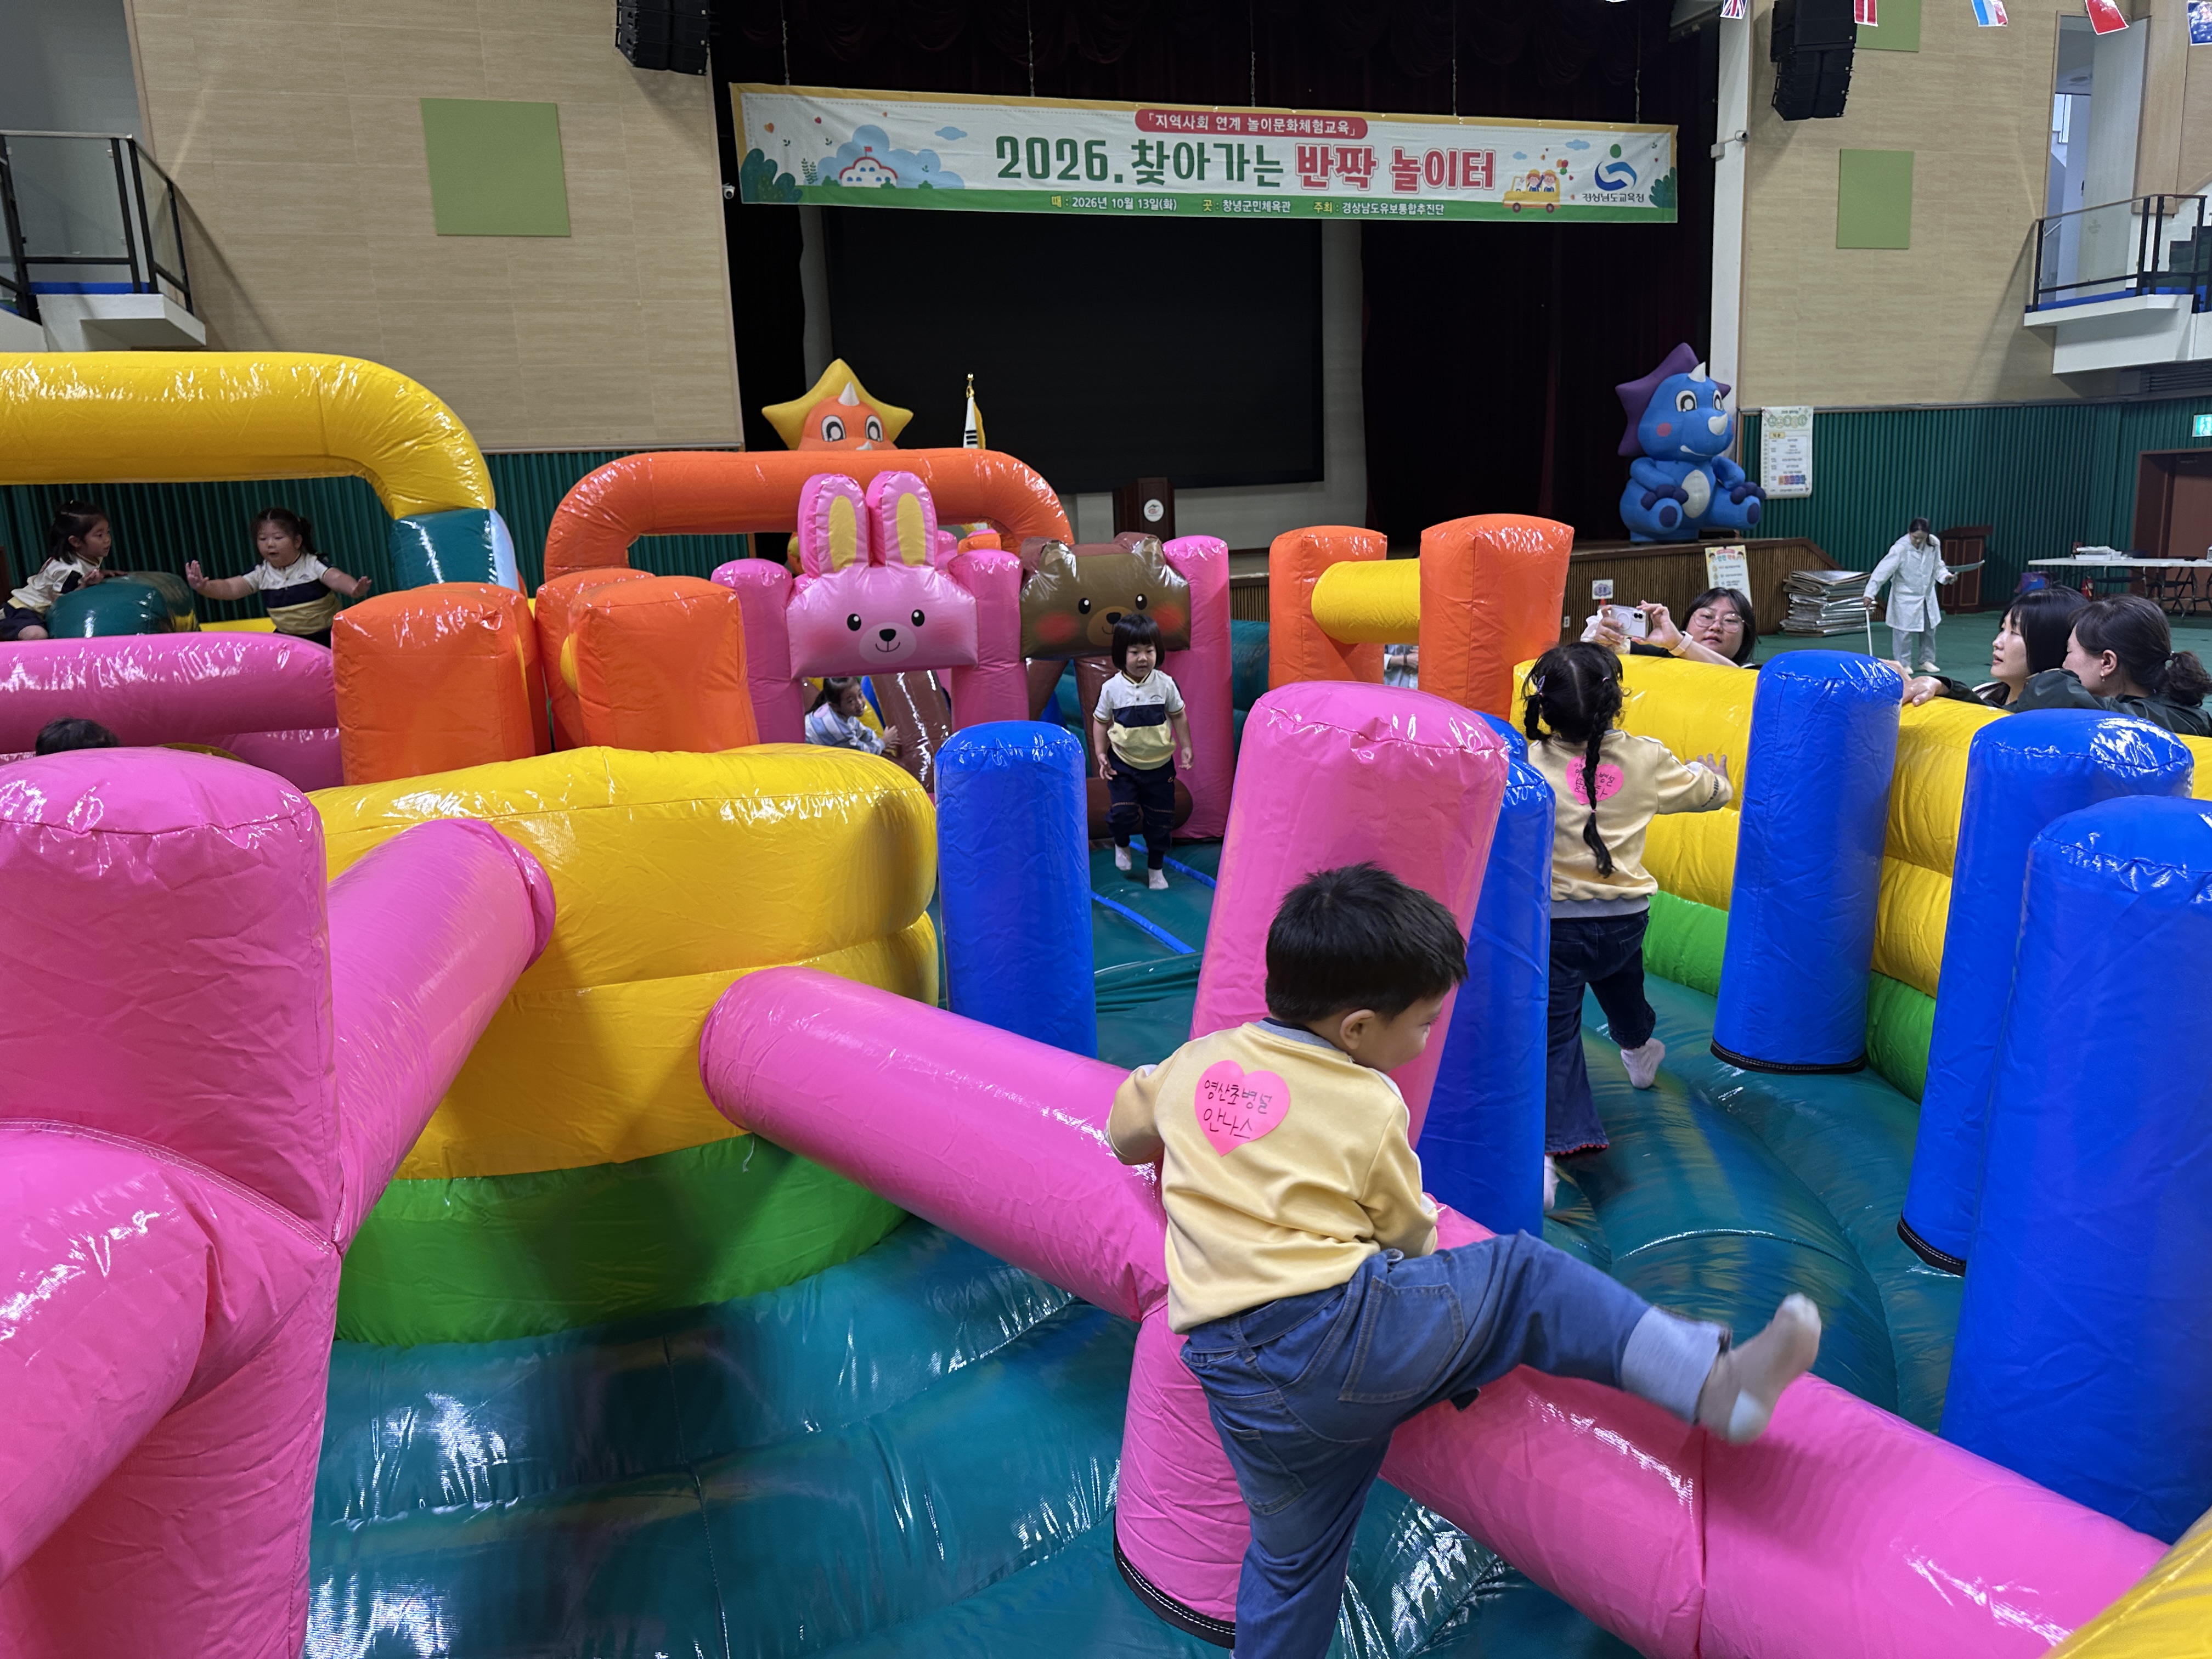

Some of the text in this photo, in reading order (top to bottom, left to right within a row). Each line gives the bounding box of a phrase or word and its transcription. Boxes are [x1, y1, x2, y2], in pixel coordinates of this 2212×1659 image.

[1148, 112, 1356, 136] 「지역사회 연계 놀이문화체험교육」
[1295, 143, 1378, 191] 반짝
[1390, 146, 1496, 195] 놀이터
[1071, 197, 1108, 210] 2026년
[1111, 198, 1133, 210] 10월
[1138, 198, 1177, 211] 13일(화)
[1582, 193, 1644, 203] 경상남도교육청
[1222, 199, 1291, 213] 창녕군민체육관
[1342, 201, 1444, 216] 경상남도유보통합추진단
[1203, 1108, 1252, 1139] 안나스
